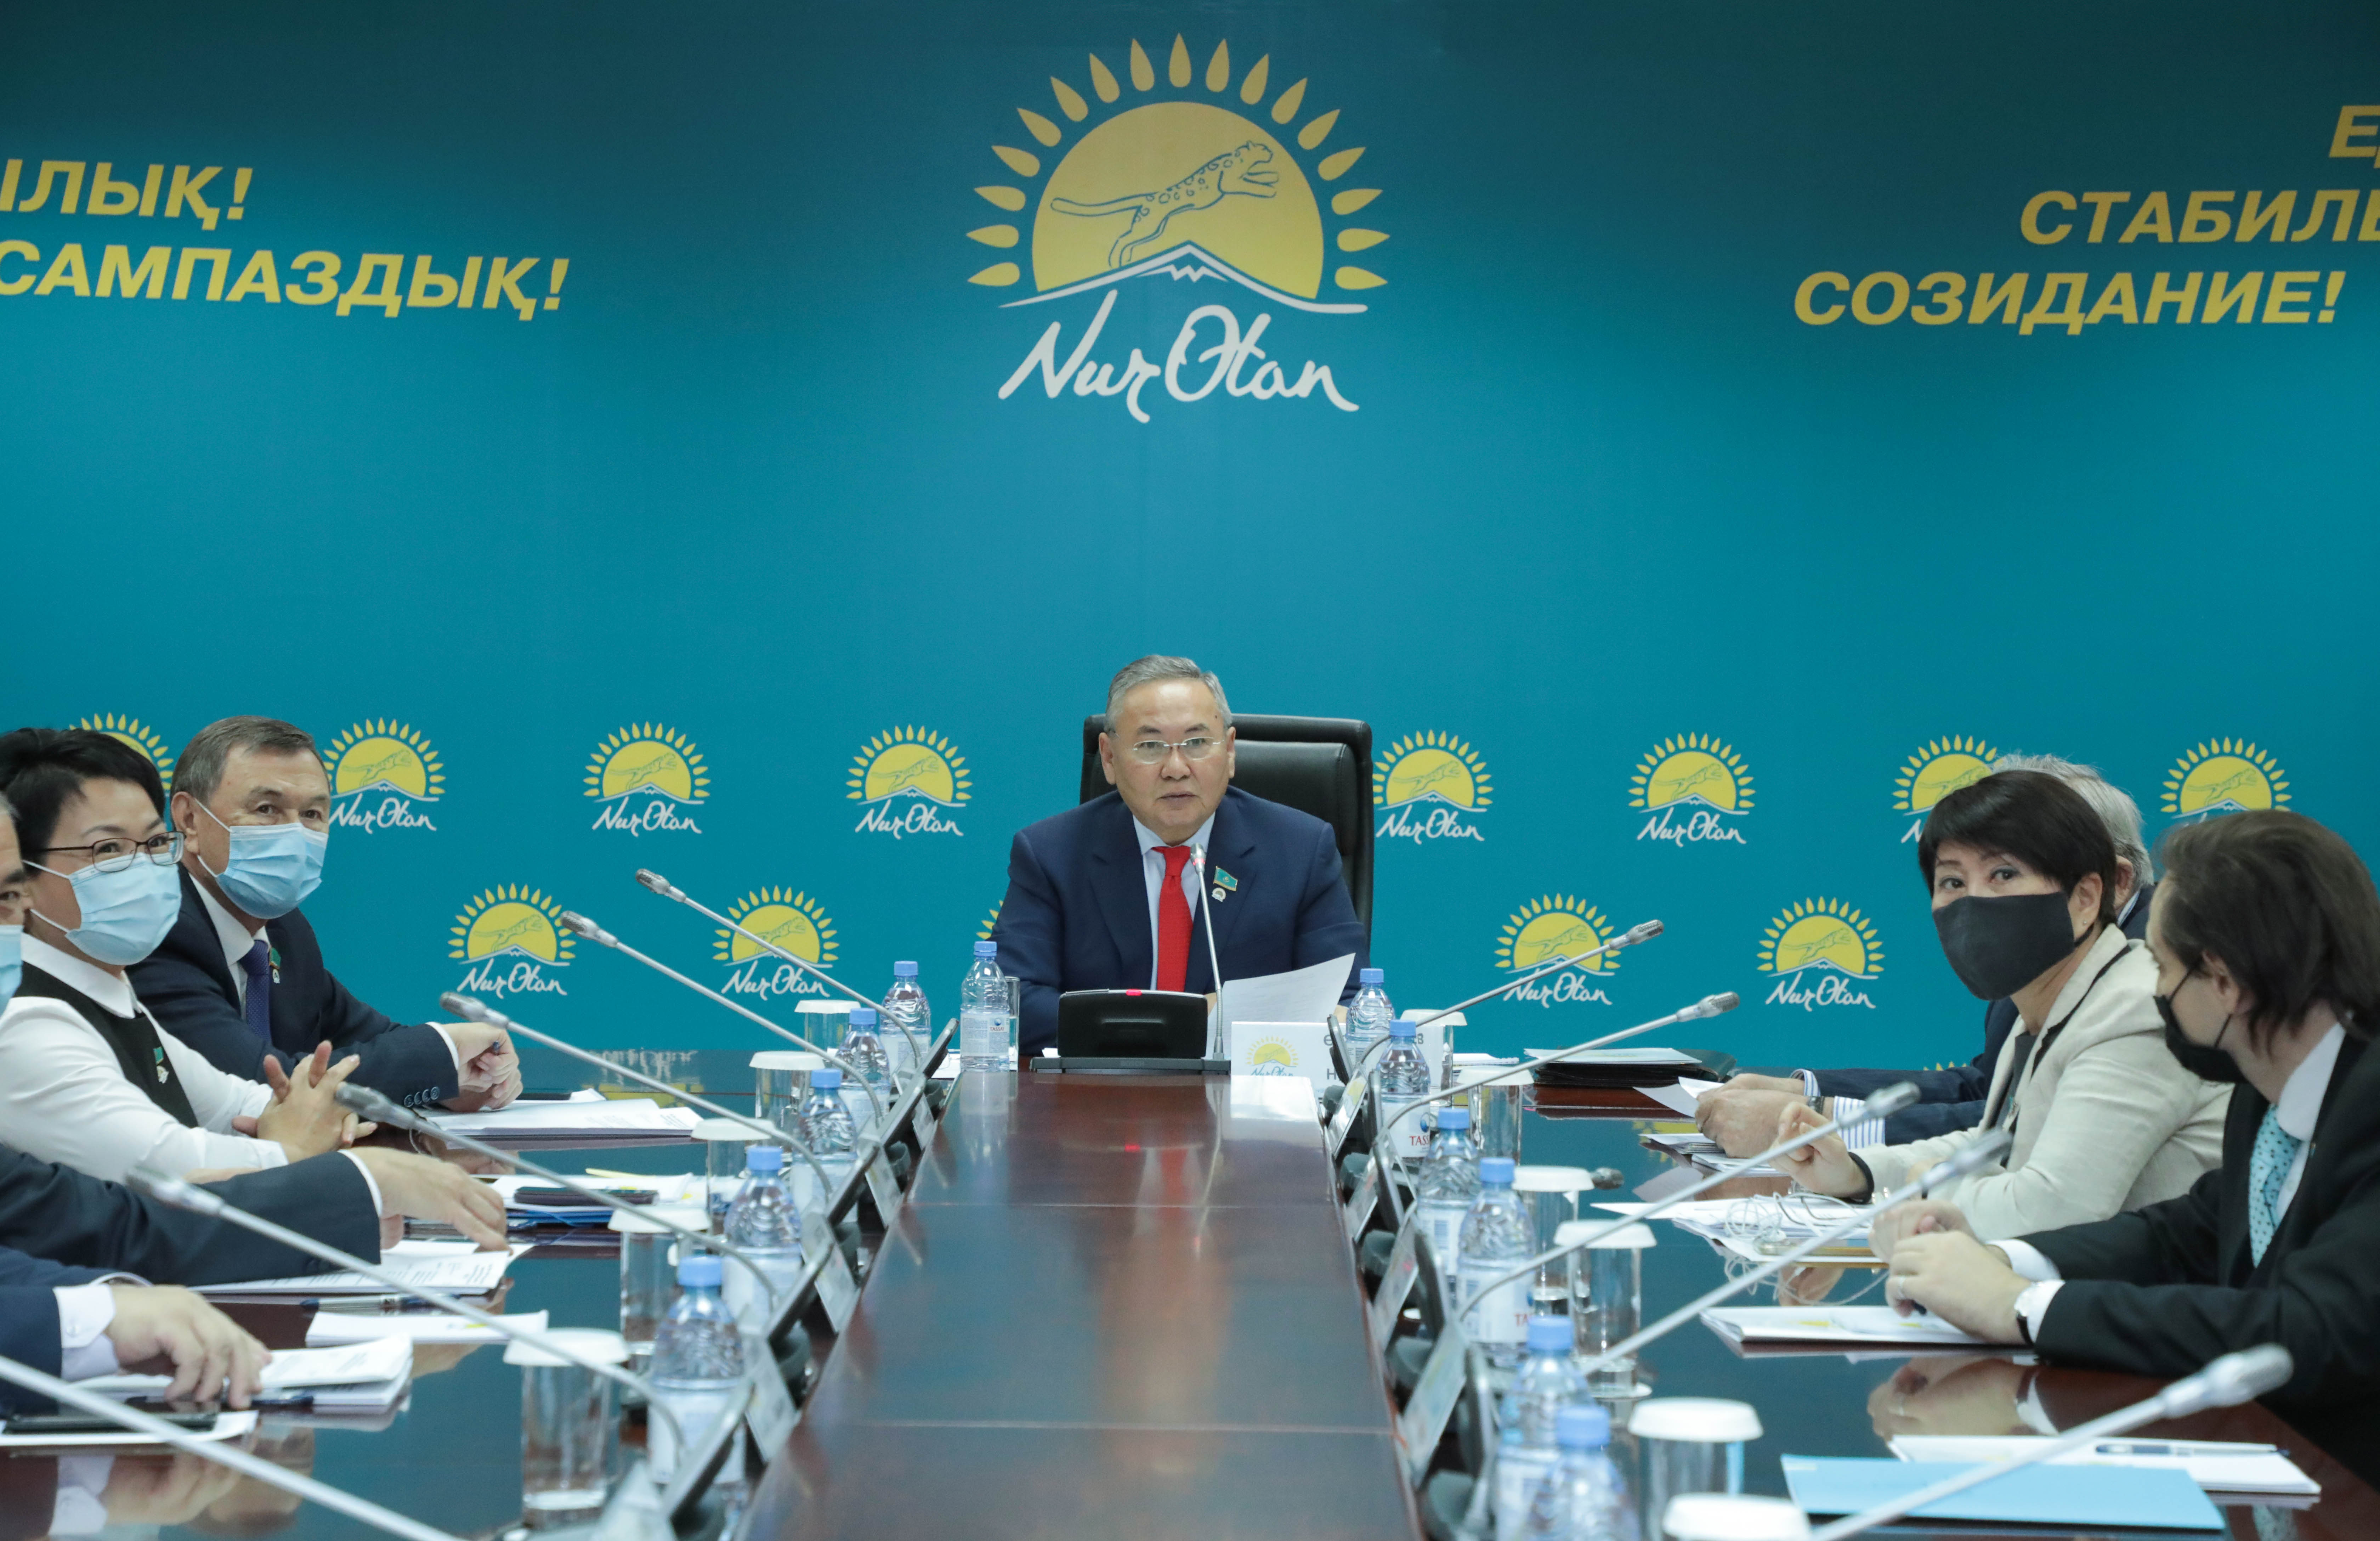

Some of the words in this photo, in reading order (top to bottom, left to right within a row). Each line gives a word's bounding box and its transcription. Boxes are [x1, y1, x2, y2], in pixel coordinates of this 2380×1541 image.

[0, 241, 569, 320] САМПАЗДЫҚ!
[1795, 271, 2345, 335] СОЗИДАНИЕ!
[998, 289, 1161, 424] Nur
[1164, 304, 1360, 412] Otan
[328, 793, 376, 834] Nur
[377, 797, 437, 831] Otan
[592, 796, 642, 837] Nur
[643, 801, 702, 834] Otan
[855, 799, 905, 839] Nur
[905, 803, 963, 836] Otan
[1376, 804, 1425, 845] Nur
[1426, 808, 1484, 841] Otan
[1637, 807, 1687, 847] Nur
[1687, 811, 1746, 844] Otan
[457, 958, 507, 999] Nur
[508, 962, 567, 995] Otan
[721, 960, 771, 1000] Nur
[771, 964, 830, 997] Otan
[1553, 972, 1612, 1005] Otan
[1766, 971, 1816, 1011] Nur
[1816, 976, 1876, 1009] Otan
